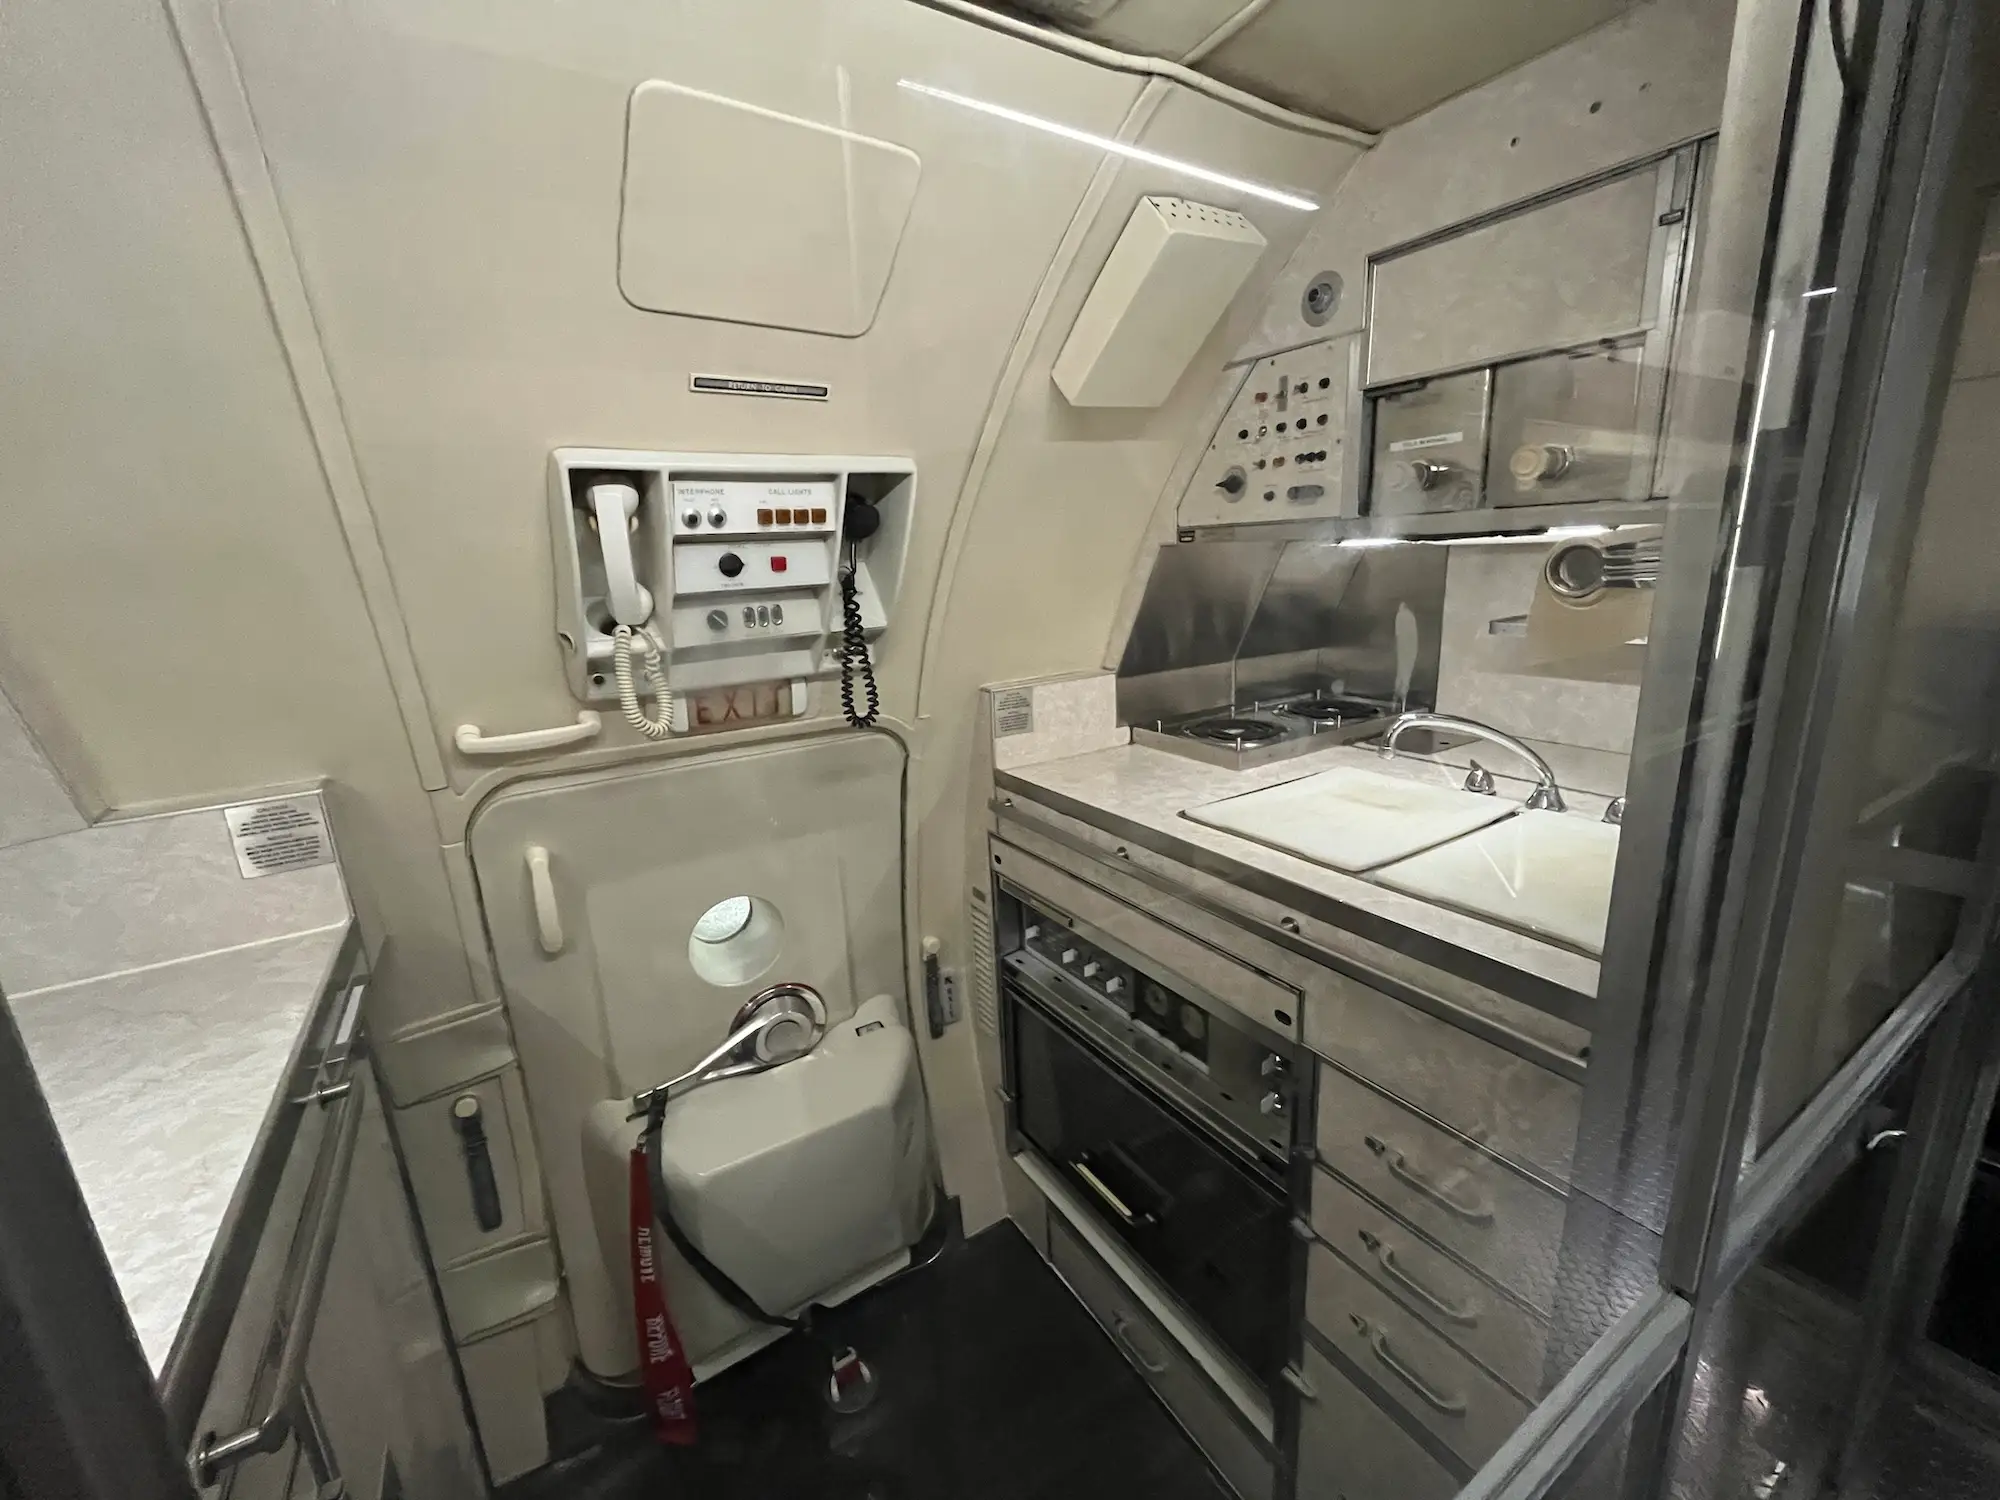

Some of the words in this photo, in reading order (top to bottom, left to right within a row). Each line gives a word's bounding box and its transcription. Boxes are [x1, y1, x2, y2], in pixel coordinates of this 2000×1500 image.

[678, 488, 725, 496] INTERPHONE
[768, 488, 786, 496] CALL
[696, 684, 785, 725] EXIT
